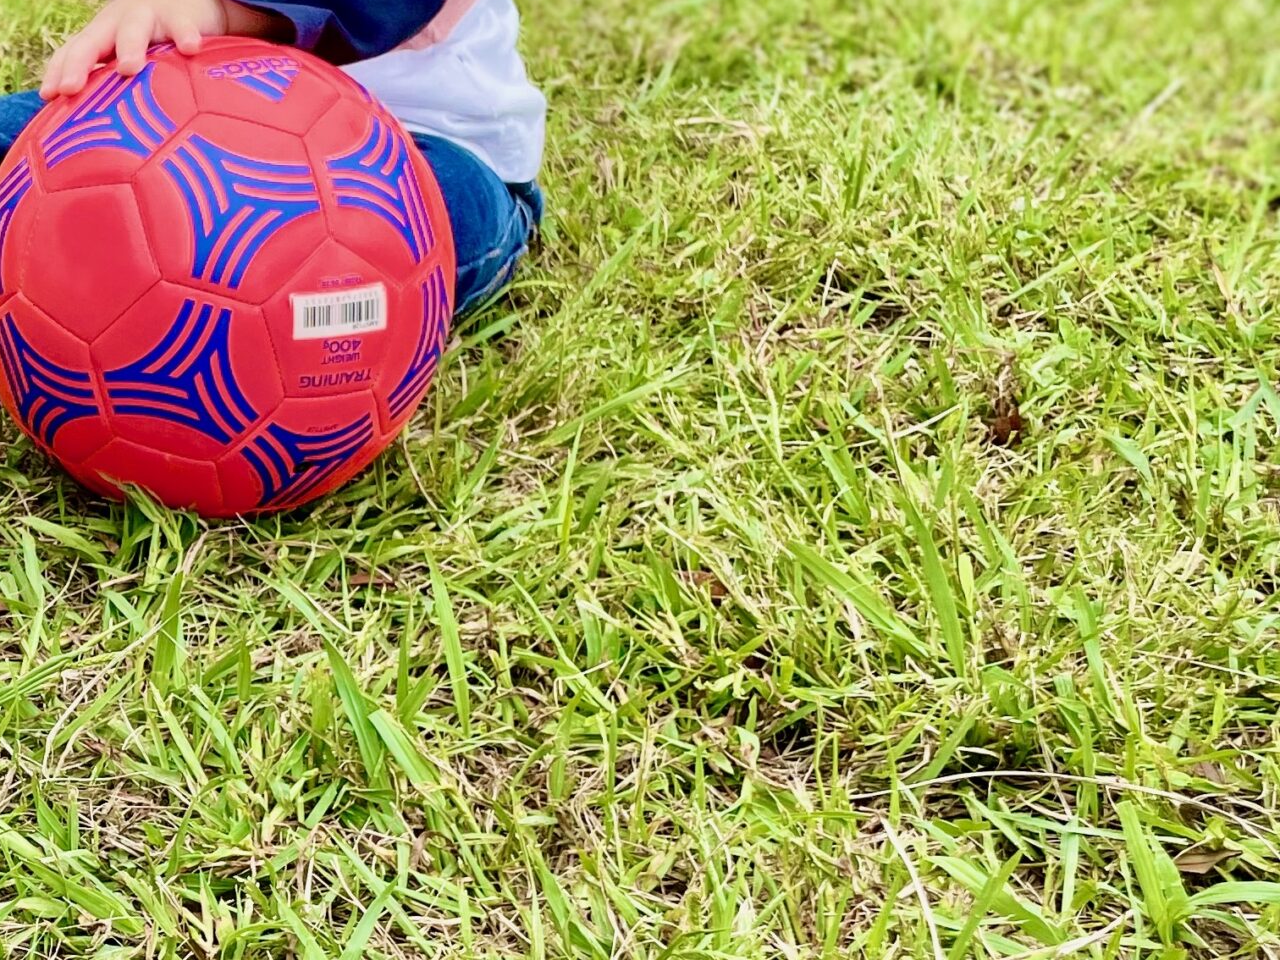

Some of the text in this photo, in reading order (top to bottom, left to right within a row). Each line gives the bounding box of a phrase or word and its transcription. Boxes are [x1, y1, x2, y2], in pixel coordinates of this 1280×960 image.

[207, 57, 301, 79] adidas
[323, 340, 362, 354] 400g
[321, 351, 361, 365] WEIGHT
[299, 368, 373, 389] TRAINING
